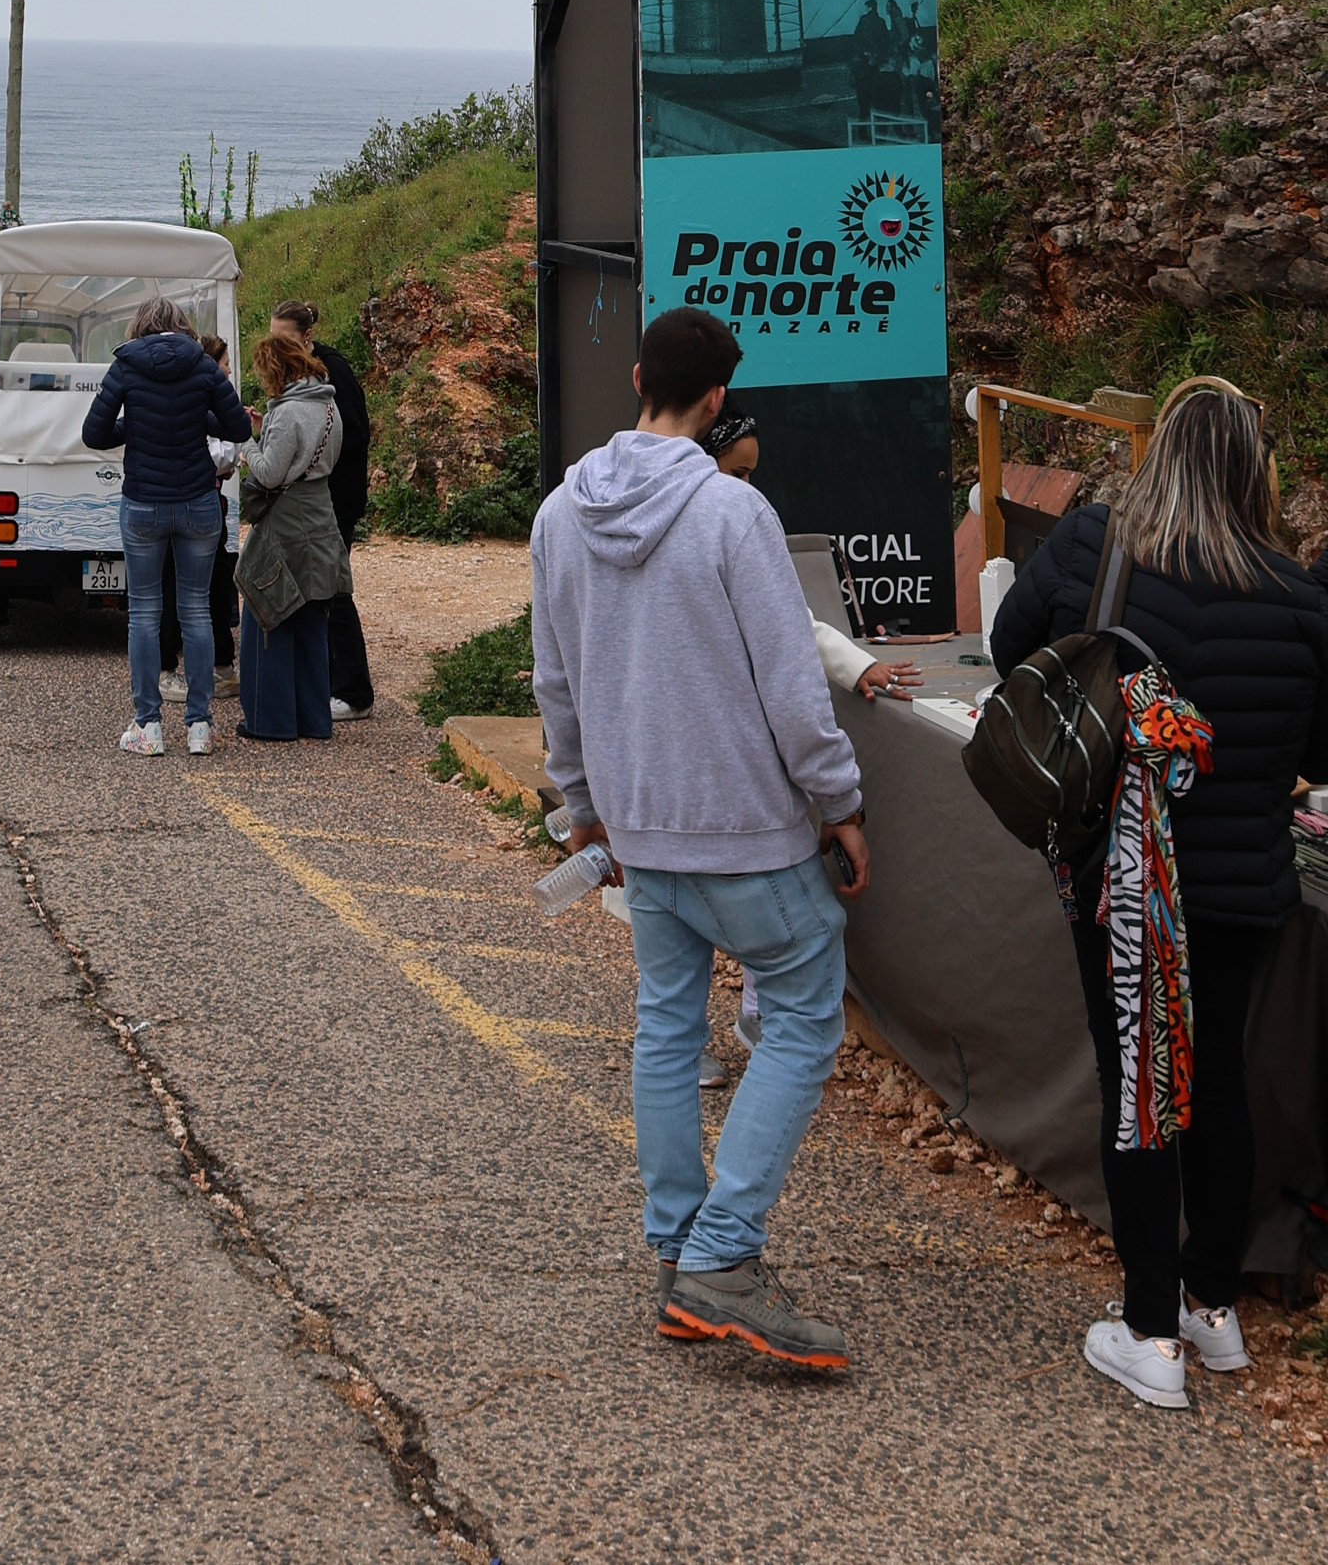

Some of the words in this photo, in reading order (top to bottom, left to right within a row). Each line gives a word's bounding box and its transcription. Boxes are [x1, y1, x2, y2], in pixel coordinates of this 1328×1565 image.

[672, 227, 837, 277] Praia
[684, 276, 729, 305] do
[730, 273, 896, 317] norte
[829, 533, 922, 562] ICIAL
[95, 561, 114, 575] AT
[840, 576, 933, 605] STORE
